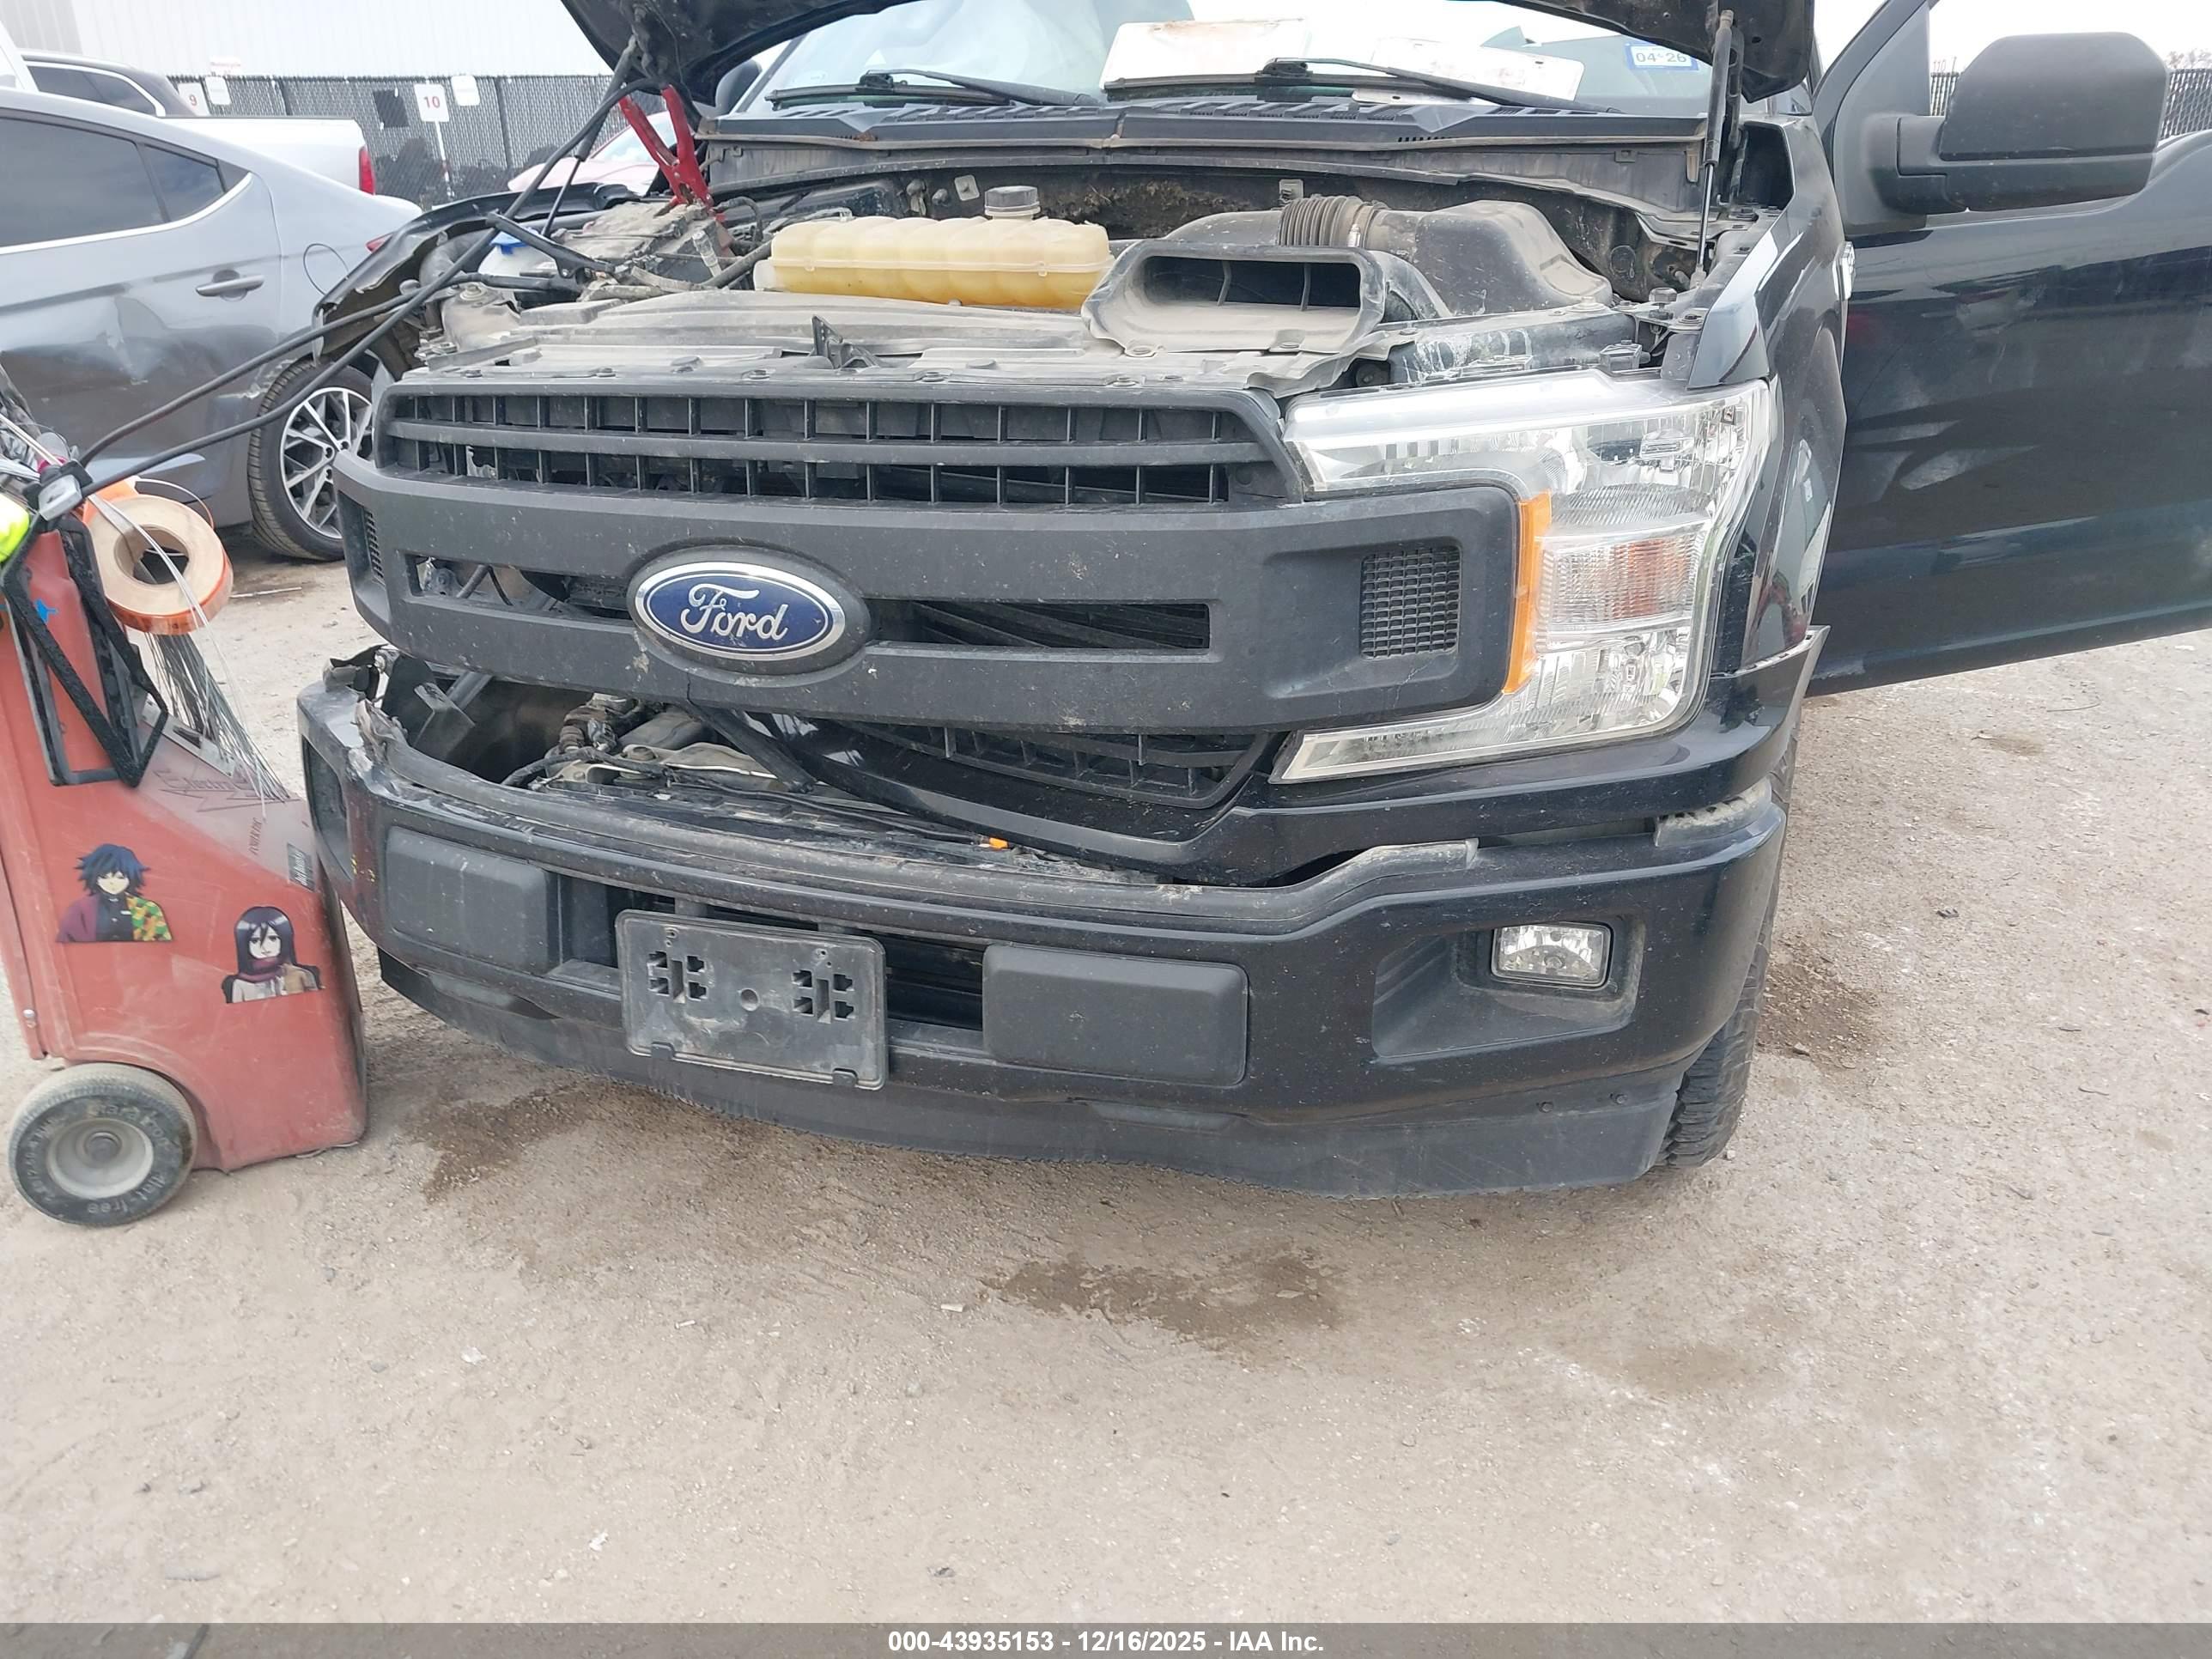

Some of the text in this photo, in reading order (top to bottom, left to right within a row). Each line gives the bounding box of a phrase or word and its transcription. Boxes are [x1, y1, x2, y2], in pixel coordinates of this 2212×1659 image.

[1635, 52, 1656, 63] 04
[189, 94, 198, 106] 9
[423, 96, 441, 108] 10
[680, 583, 789, 641] Ford
